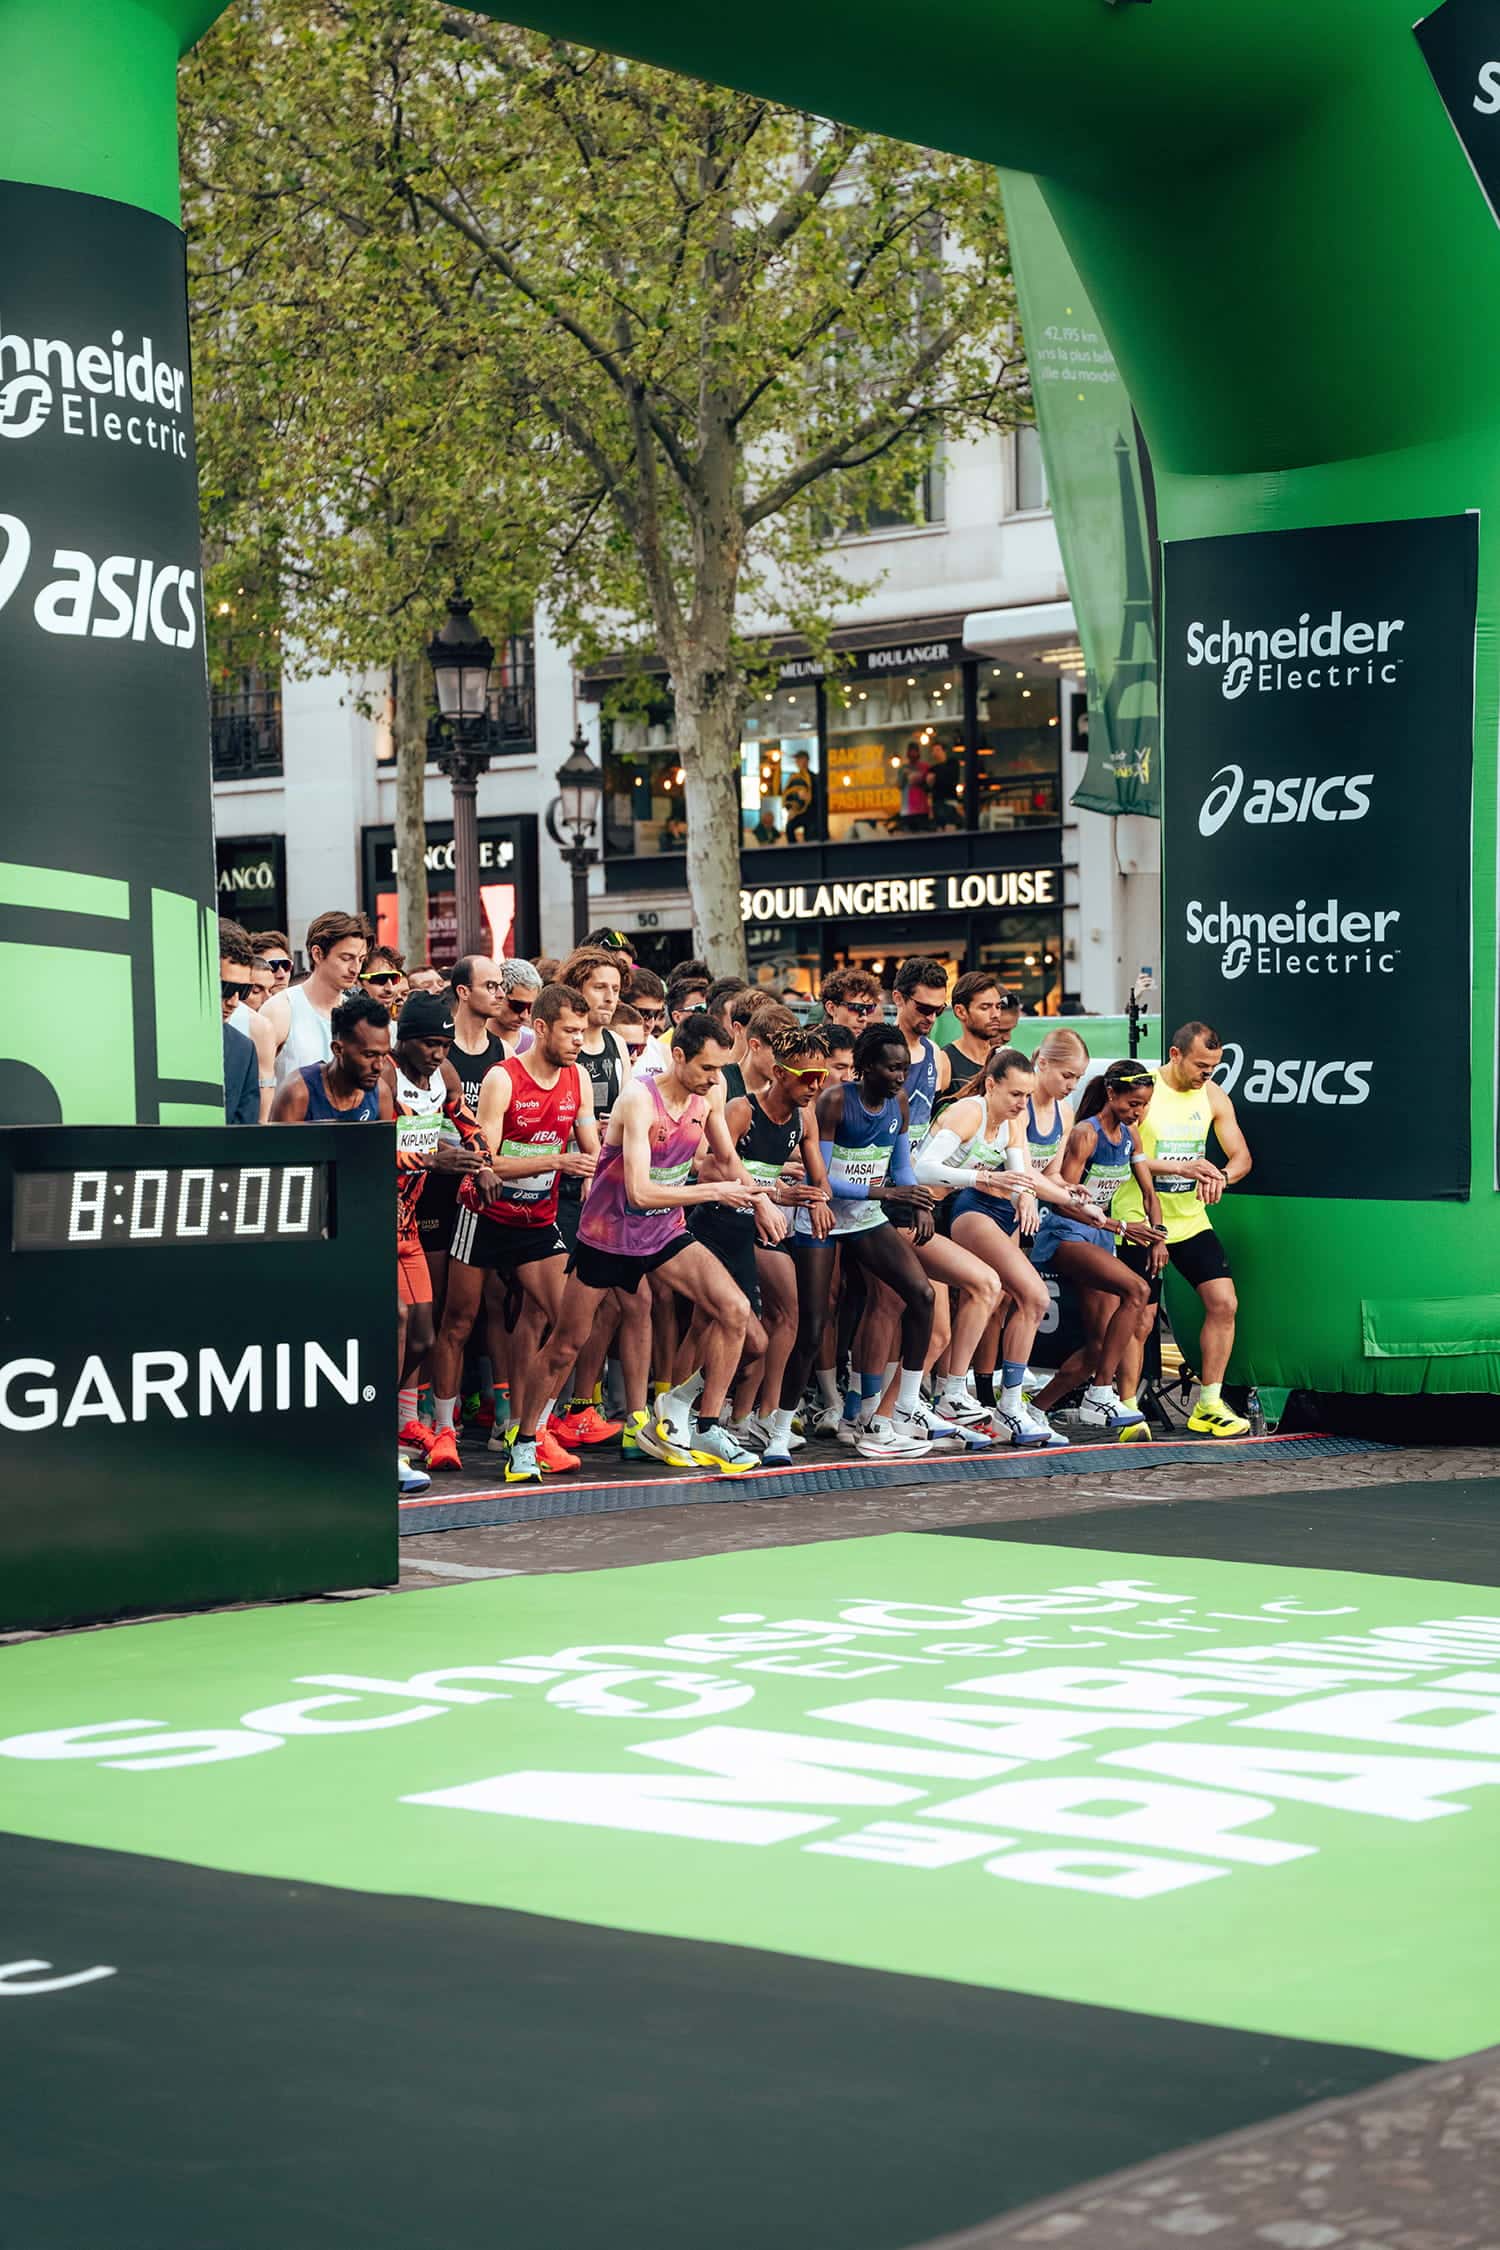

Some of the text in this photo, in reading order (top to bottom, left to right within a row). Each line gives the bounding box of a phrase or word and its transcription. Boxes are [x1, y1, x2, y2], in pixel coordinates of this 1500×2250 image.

[62, 393, 187, 459] Electric
[868, 644, 949, 669] BOULANGER
[1187, 611, 1405, 666] Schneider
[1258, 659, 1397, 692] Electric
[1243, 774, 1374, 823] asics
[947, 870, 1054, 909] LOUISE
[638, 911, 658, 927] 50
[1186, 899, 1400, 944] Schneider
[1257, 948, 1395, 974] Electric
[1243, 1059, 1374, 1104] asics
[844, 1163, 876, 1175] MASAI
[68, 1167, 313, 1241] 8:00:00
[731, 1596, 1360, 1679] Electric
[0, 1579, 1197, 1771] Schneider
